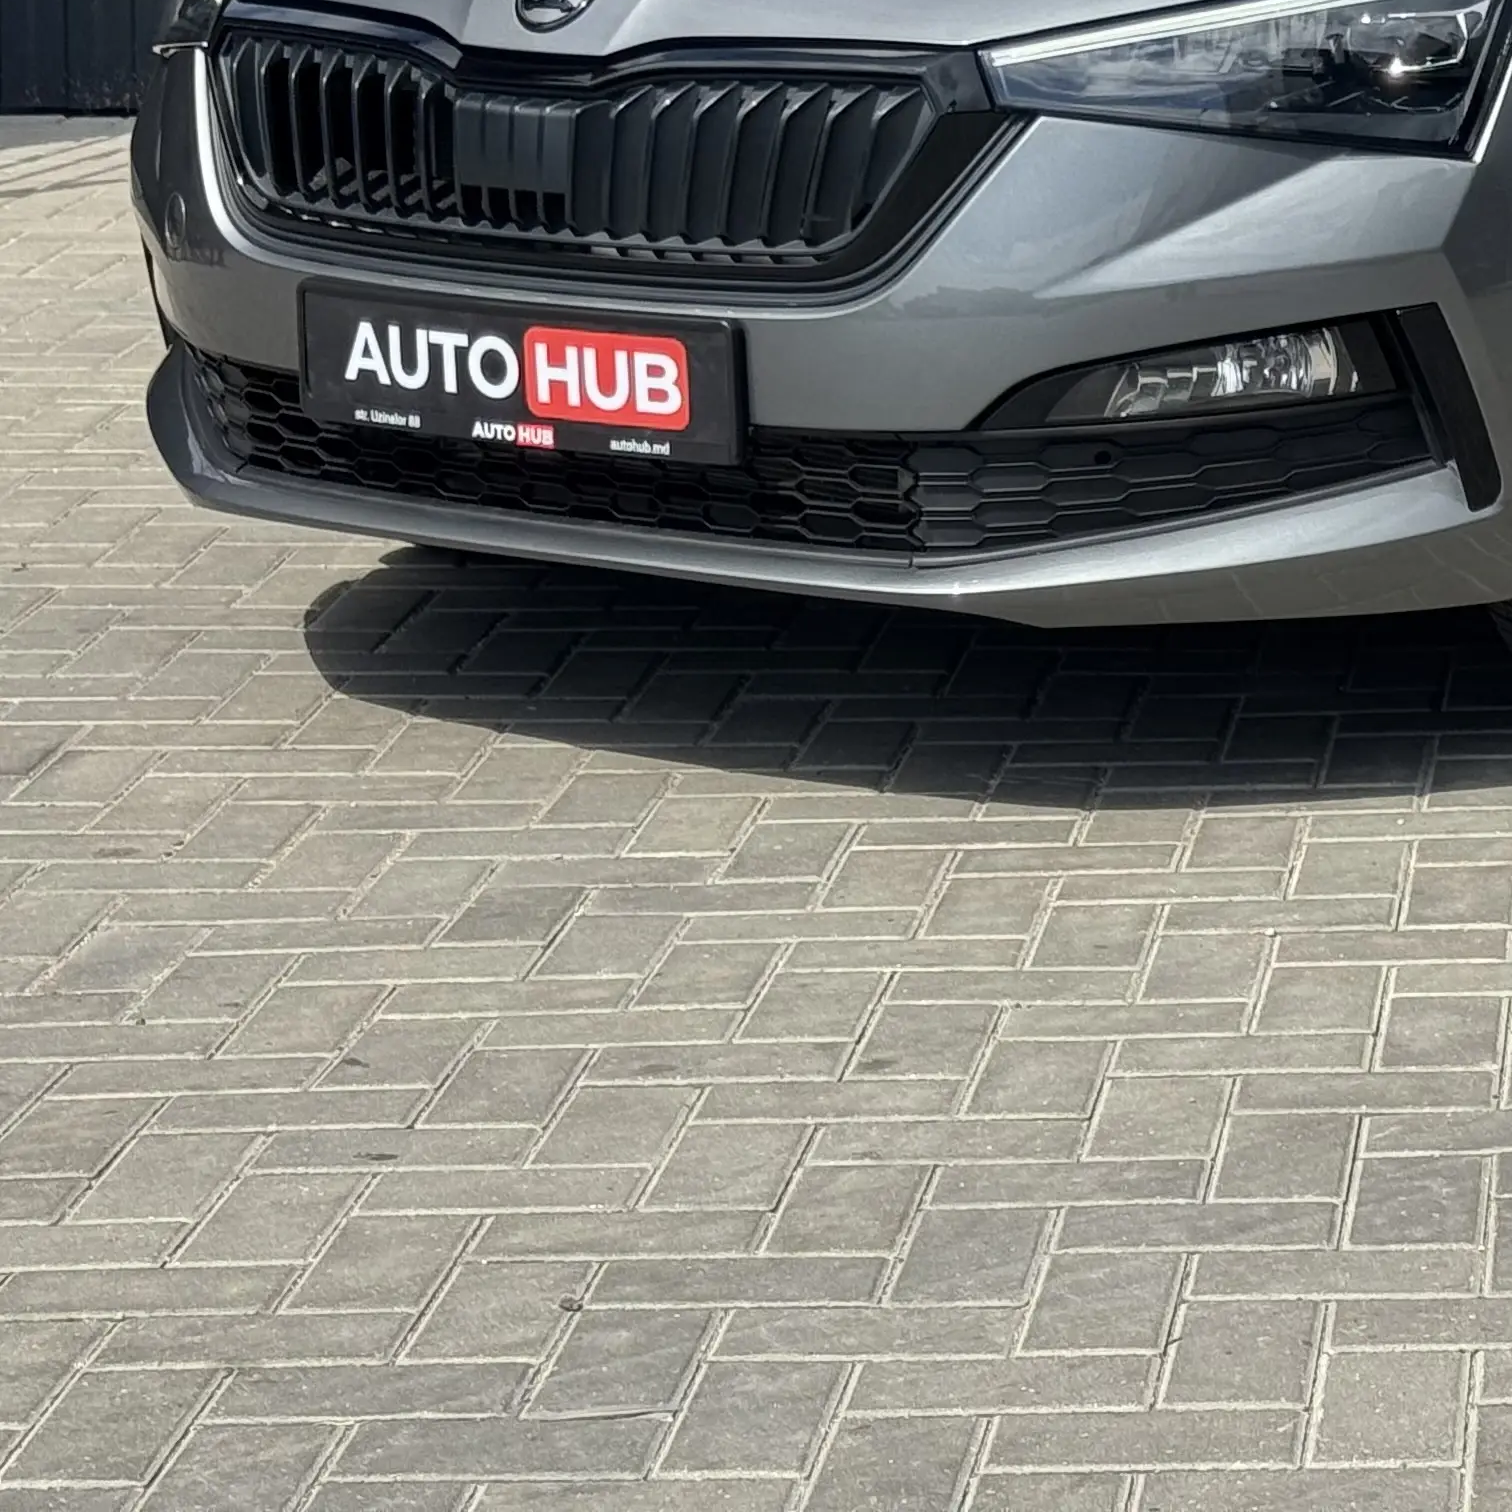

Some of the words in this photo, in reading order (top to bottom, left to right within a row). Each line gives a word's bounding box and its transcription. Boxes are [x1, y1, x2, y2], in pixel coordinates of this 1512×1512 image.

[344, 321, 519, 399] AUTO
[534, 341, 683, 415] HUB
[472, 420, 516, 441] AUTO
[518, 424, 554, 446] HUB
[610, 438, 670, 455] autohub.md
